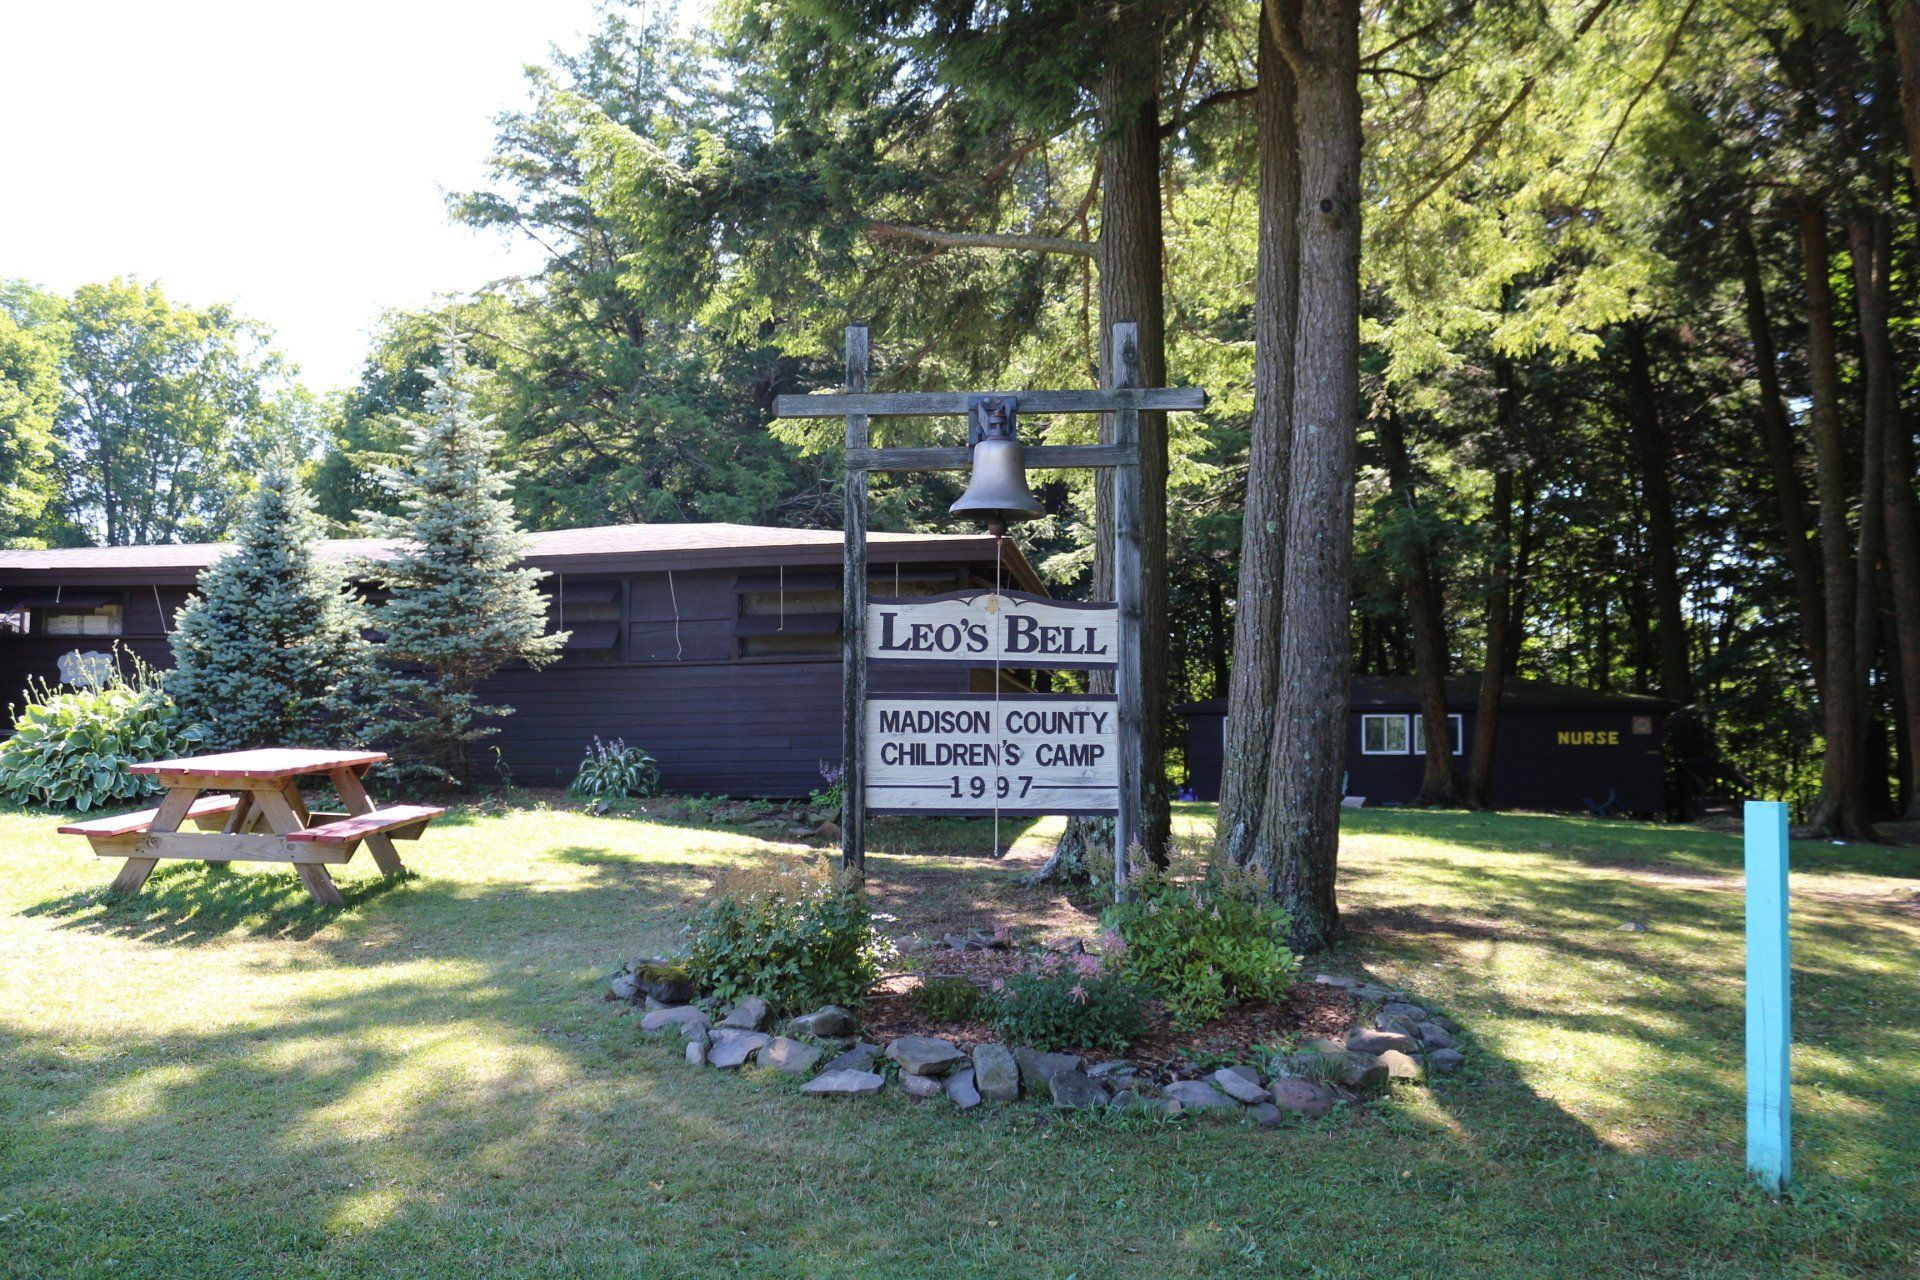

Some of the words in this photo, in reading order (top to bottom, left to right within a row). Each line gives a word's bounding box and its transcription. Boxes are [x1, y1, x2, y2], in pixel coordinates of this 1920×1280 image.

[878, 612, 989, 653] LEO'S
[1004, 614, 1108, 655] BELL
[879, 710, 990, 734] MADISON
[1005, 711, 1109, 735] COUNTY
[1557, 731, 1620, 746] NURSE
[880, 739, 1020, 767] CHILDREN'S
[1035, 743, 1105, 767] CAMP
